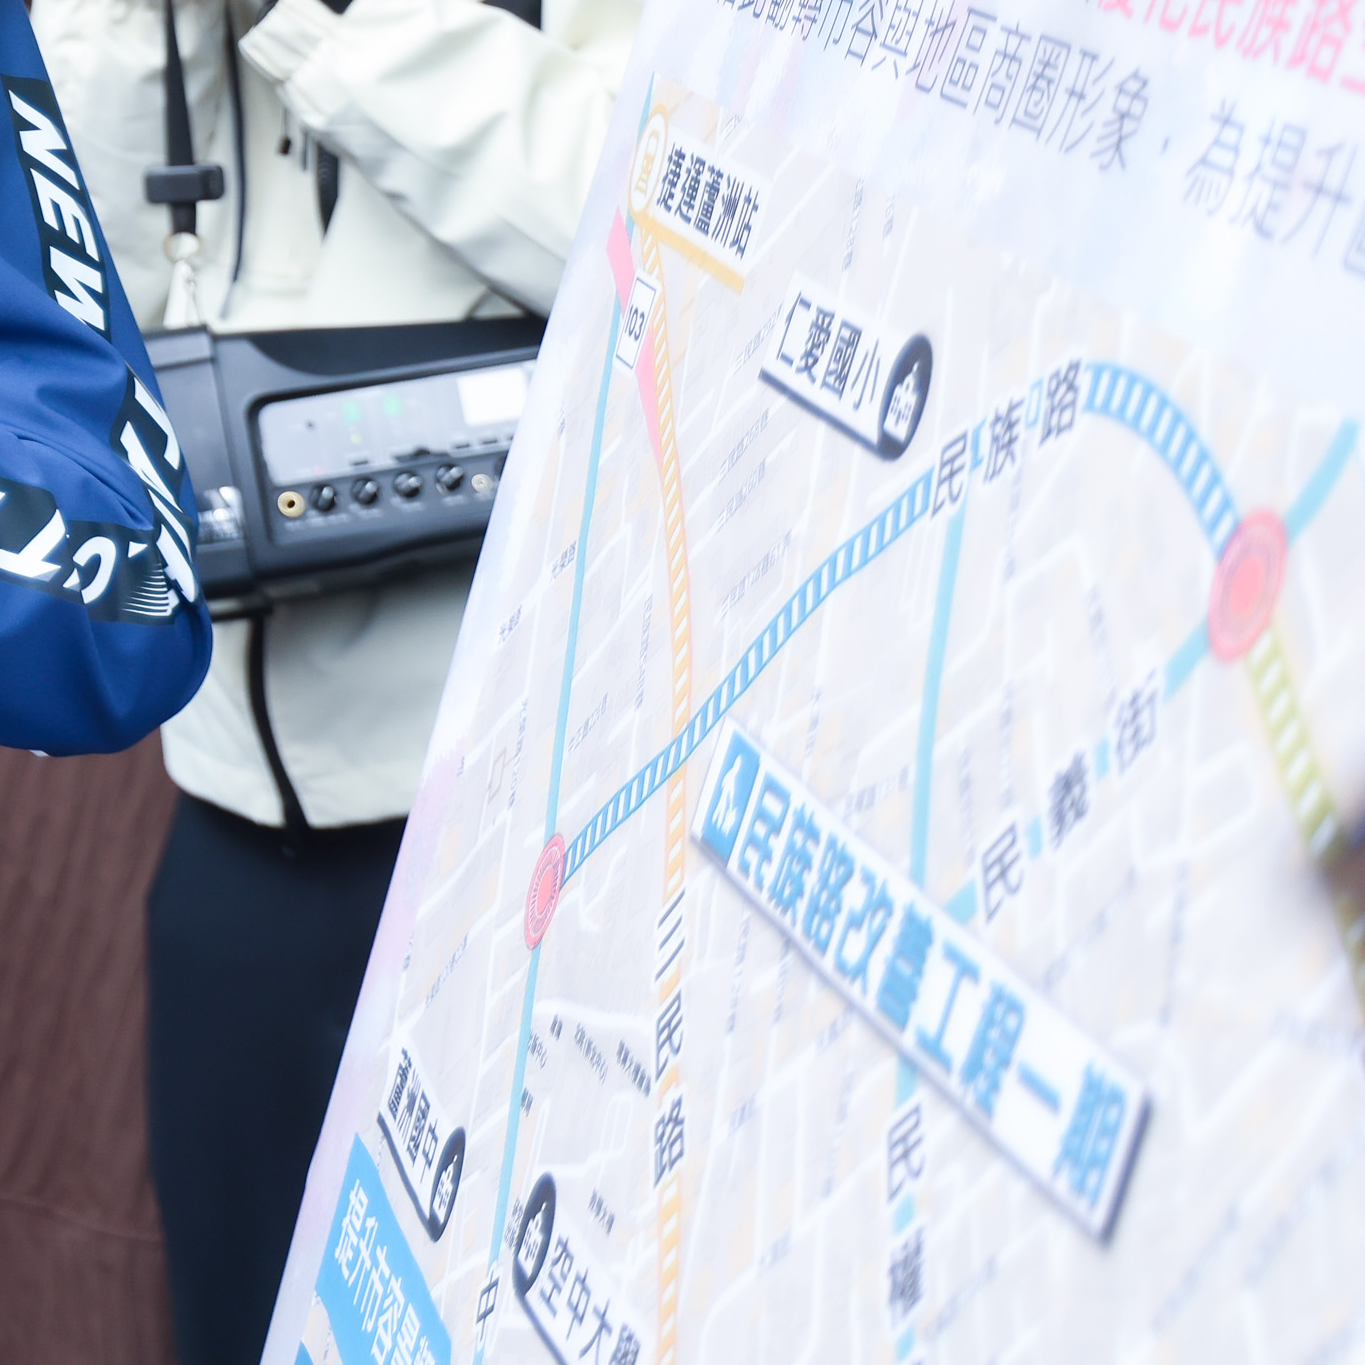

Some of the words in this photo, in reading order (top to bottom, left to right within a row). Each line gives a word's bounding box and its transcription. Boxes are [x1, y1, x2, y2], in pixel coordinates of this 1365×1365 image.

[8, 89, 106, 331] NEW
[656, 142, 758, 260] 捷運蘆洲站
[624, 303, 648, 344] 103
[776, 291, 880, 411] 仁愛國小
[930, 358, 1083, 518] 民族路
[654, 888, 686, 1189] 三民路
[737, 772, 1128, 1211] 民族路改善工程一期
[388, 1048, 439, 1184] 蘆洲國中
